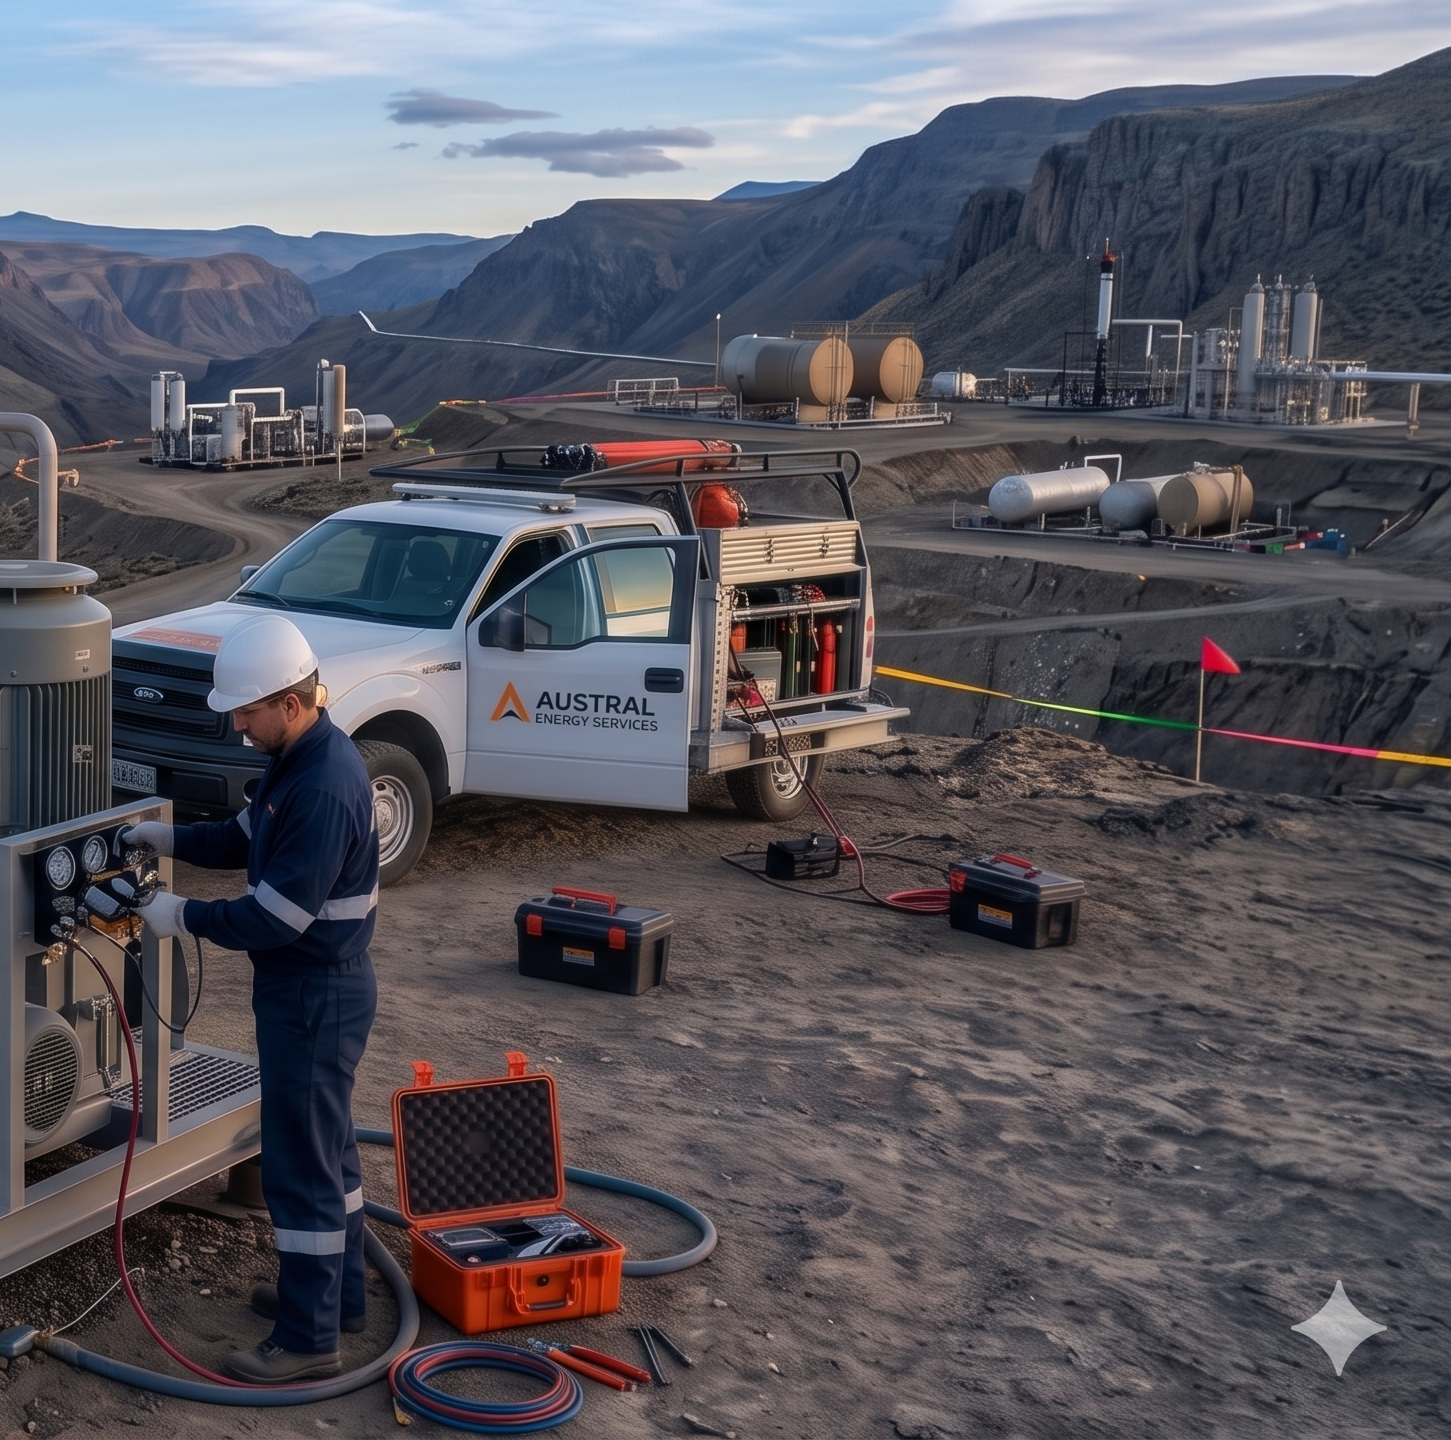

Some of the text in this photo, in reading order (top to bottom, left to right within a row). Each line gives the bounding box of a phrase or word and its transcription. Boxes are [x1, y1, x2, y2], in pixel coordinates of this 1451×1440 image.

[536, 691, 655, 717] AUSTRAL
[535, 713, 658, 732] ENERGY SERVICES
